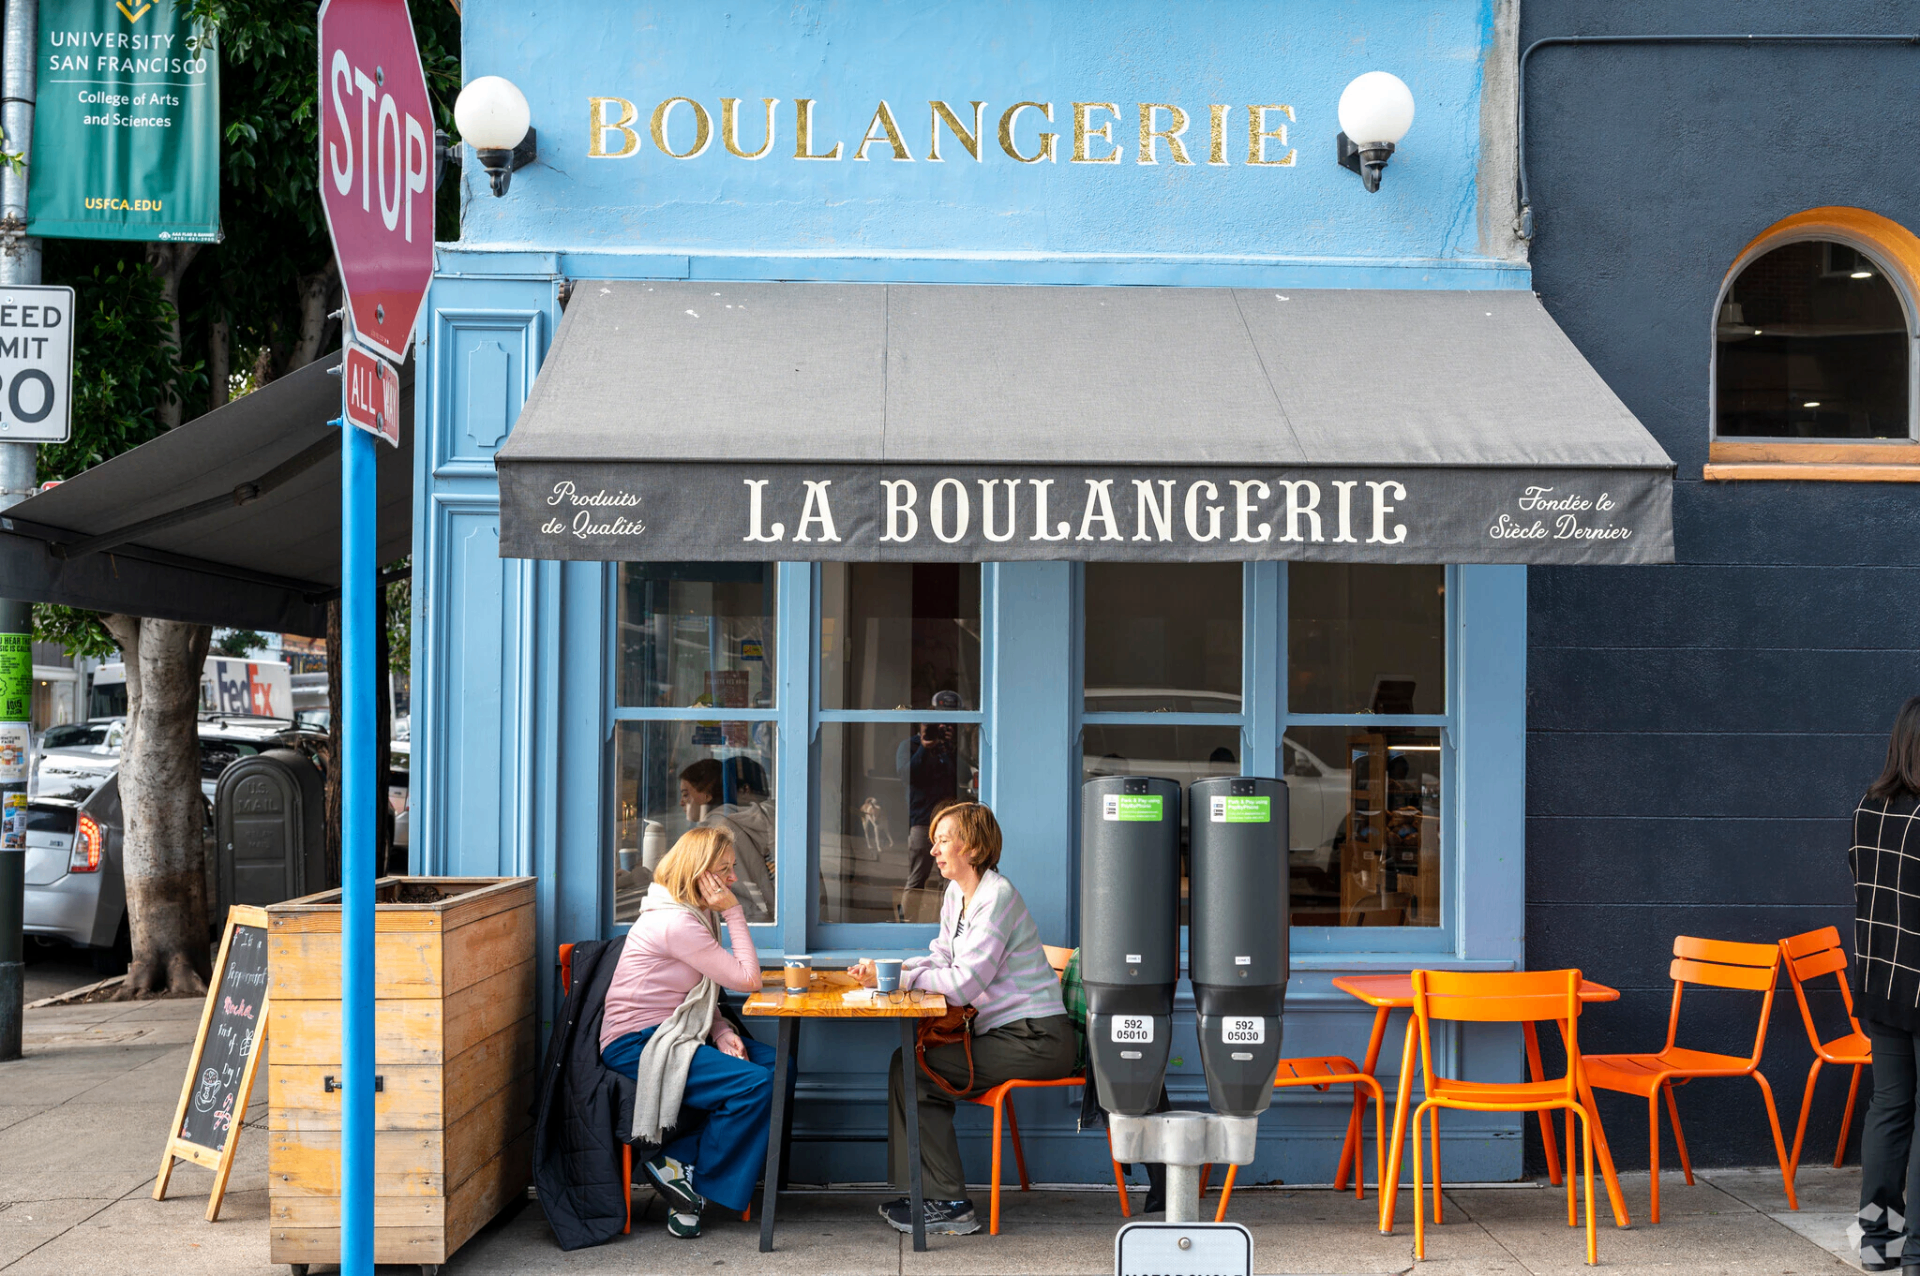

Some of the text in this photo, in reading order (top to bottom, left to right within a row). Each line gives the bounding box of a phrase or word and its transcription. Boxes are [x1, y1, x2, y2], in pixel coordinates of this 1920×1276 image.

[51, 31, 175, 50] UNIVERSITY
[50, 55, 207, 75] SAN FRANCISCO
[78, 90, 179, 107] College of Arts
[83, 113, 172, 128] and Sciences
[586, 96, 1298, 167] BOULANGERIE
[329, 48, 428, 244] STOP
[85, 197, 163, 212] USFCA.EDU
[0, 368, 55, 424] 0
[351, 363, 376, 415] ALL
[382, 377, 397, 428] WAY
[546, 480, 642, 507] Produits
[1518, 485, 1616, 512] Fondée le
[743, 478, 1407, 545] LA BOULANGERIE
[541, 510, 646, 540] de Qualité
[1489, 514, 1633, 540] Siècle Dernier
[216, 661, 275, 718] FedEx
[247, 782, 271, 795] U.S.
[238, 799, 279, 813] MAIL
[1116, 1030, 1148, 1040] 05010
[1124, 1019, 1143, 1029] 592
[1235, 1020, 1254, 1030] 592
[1227, 1031, 1259, 1041] 05030
